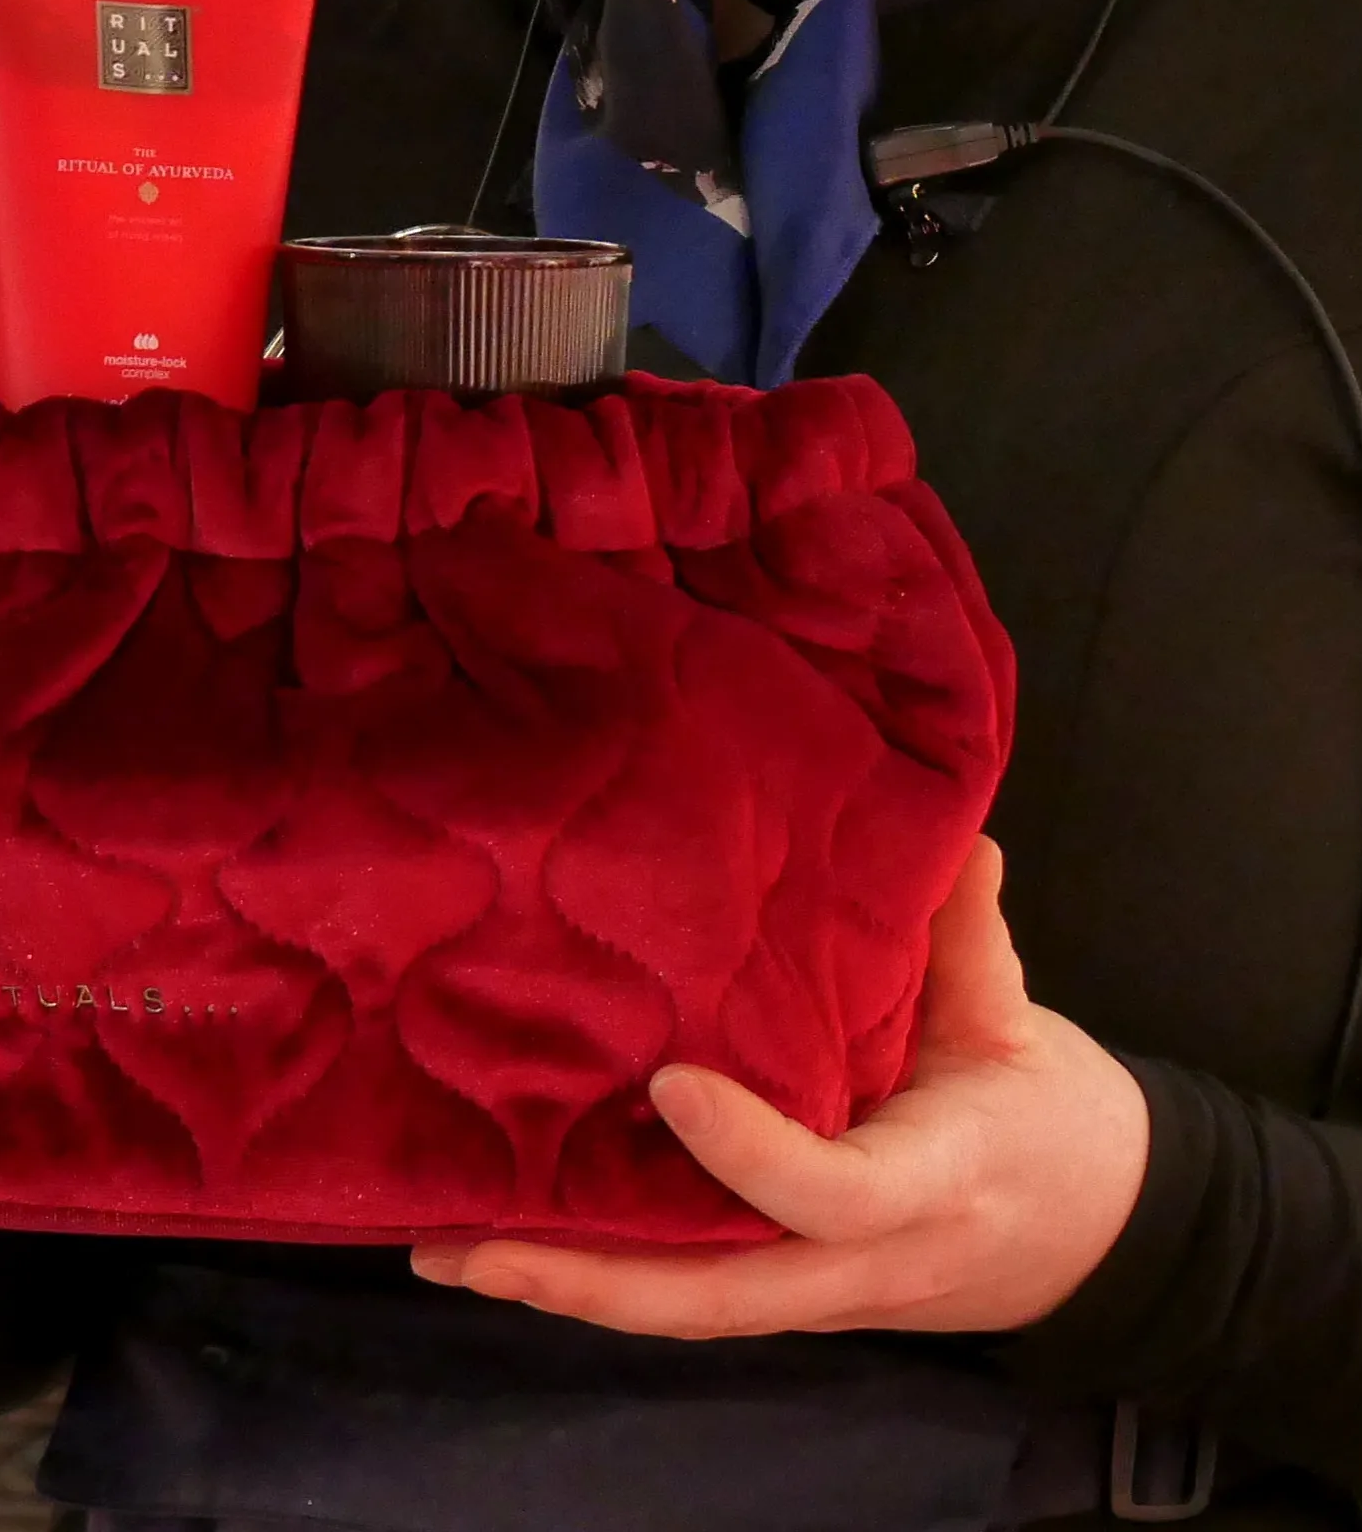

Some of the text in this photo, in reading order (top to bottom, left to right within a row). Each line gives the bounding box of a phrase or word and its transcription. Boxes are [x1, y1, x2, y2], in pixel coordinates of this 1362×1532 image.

[133, 148, 157, 158] THE
[57, 159, 235, 181] RITUAL OF AYURVEDA
[104, 354, 187, 368] moisture-lock
[121, 368, 171, 380] complex
